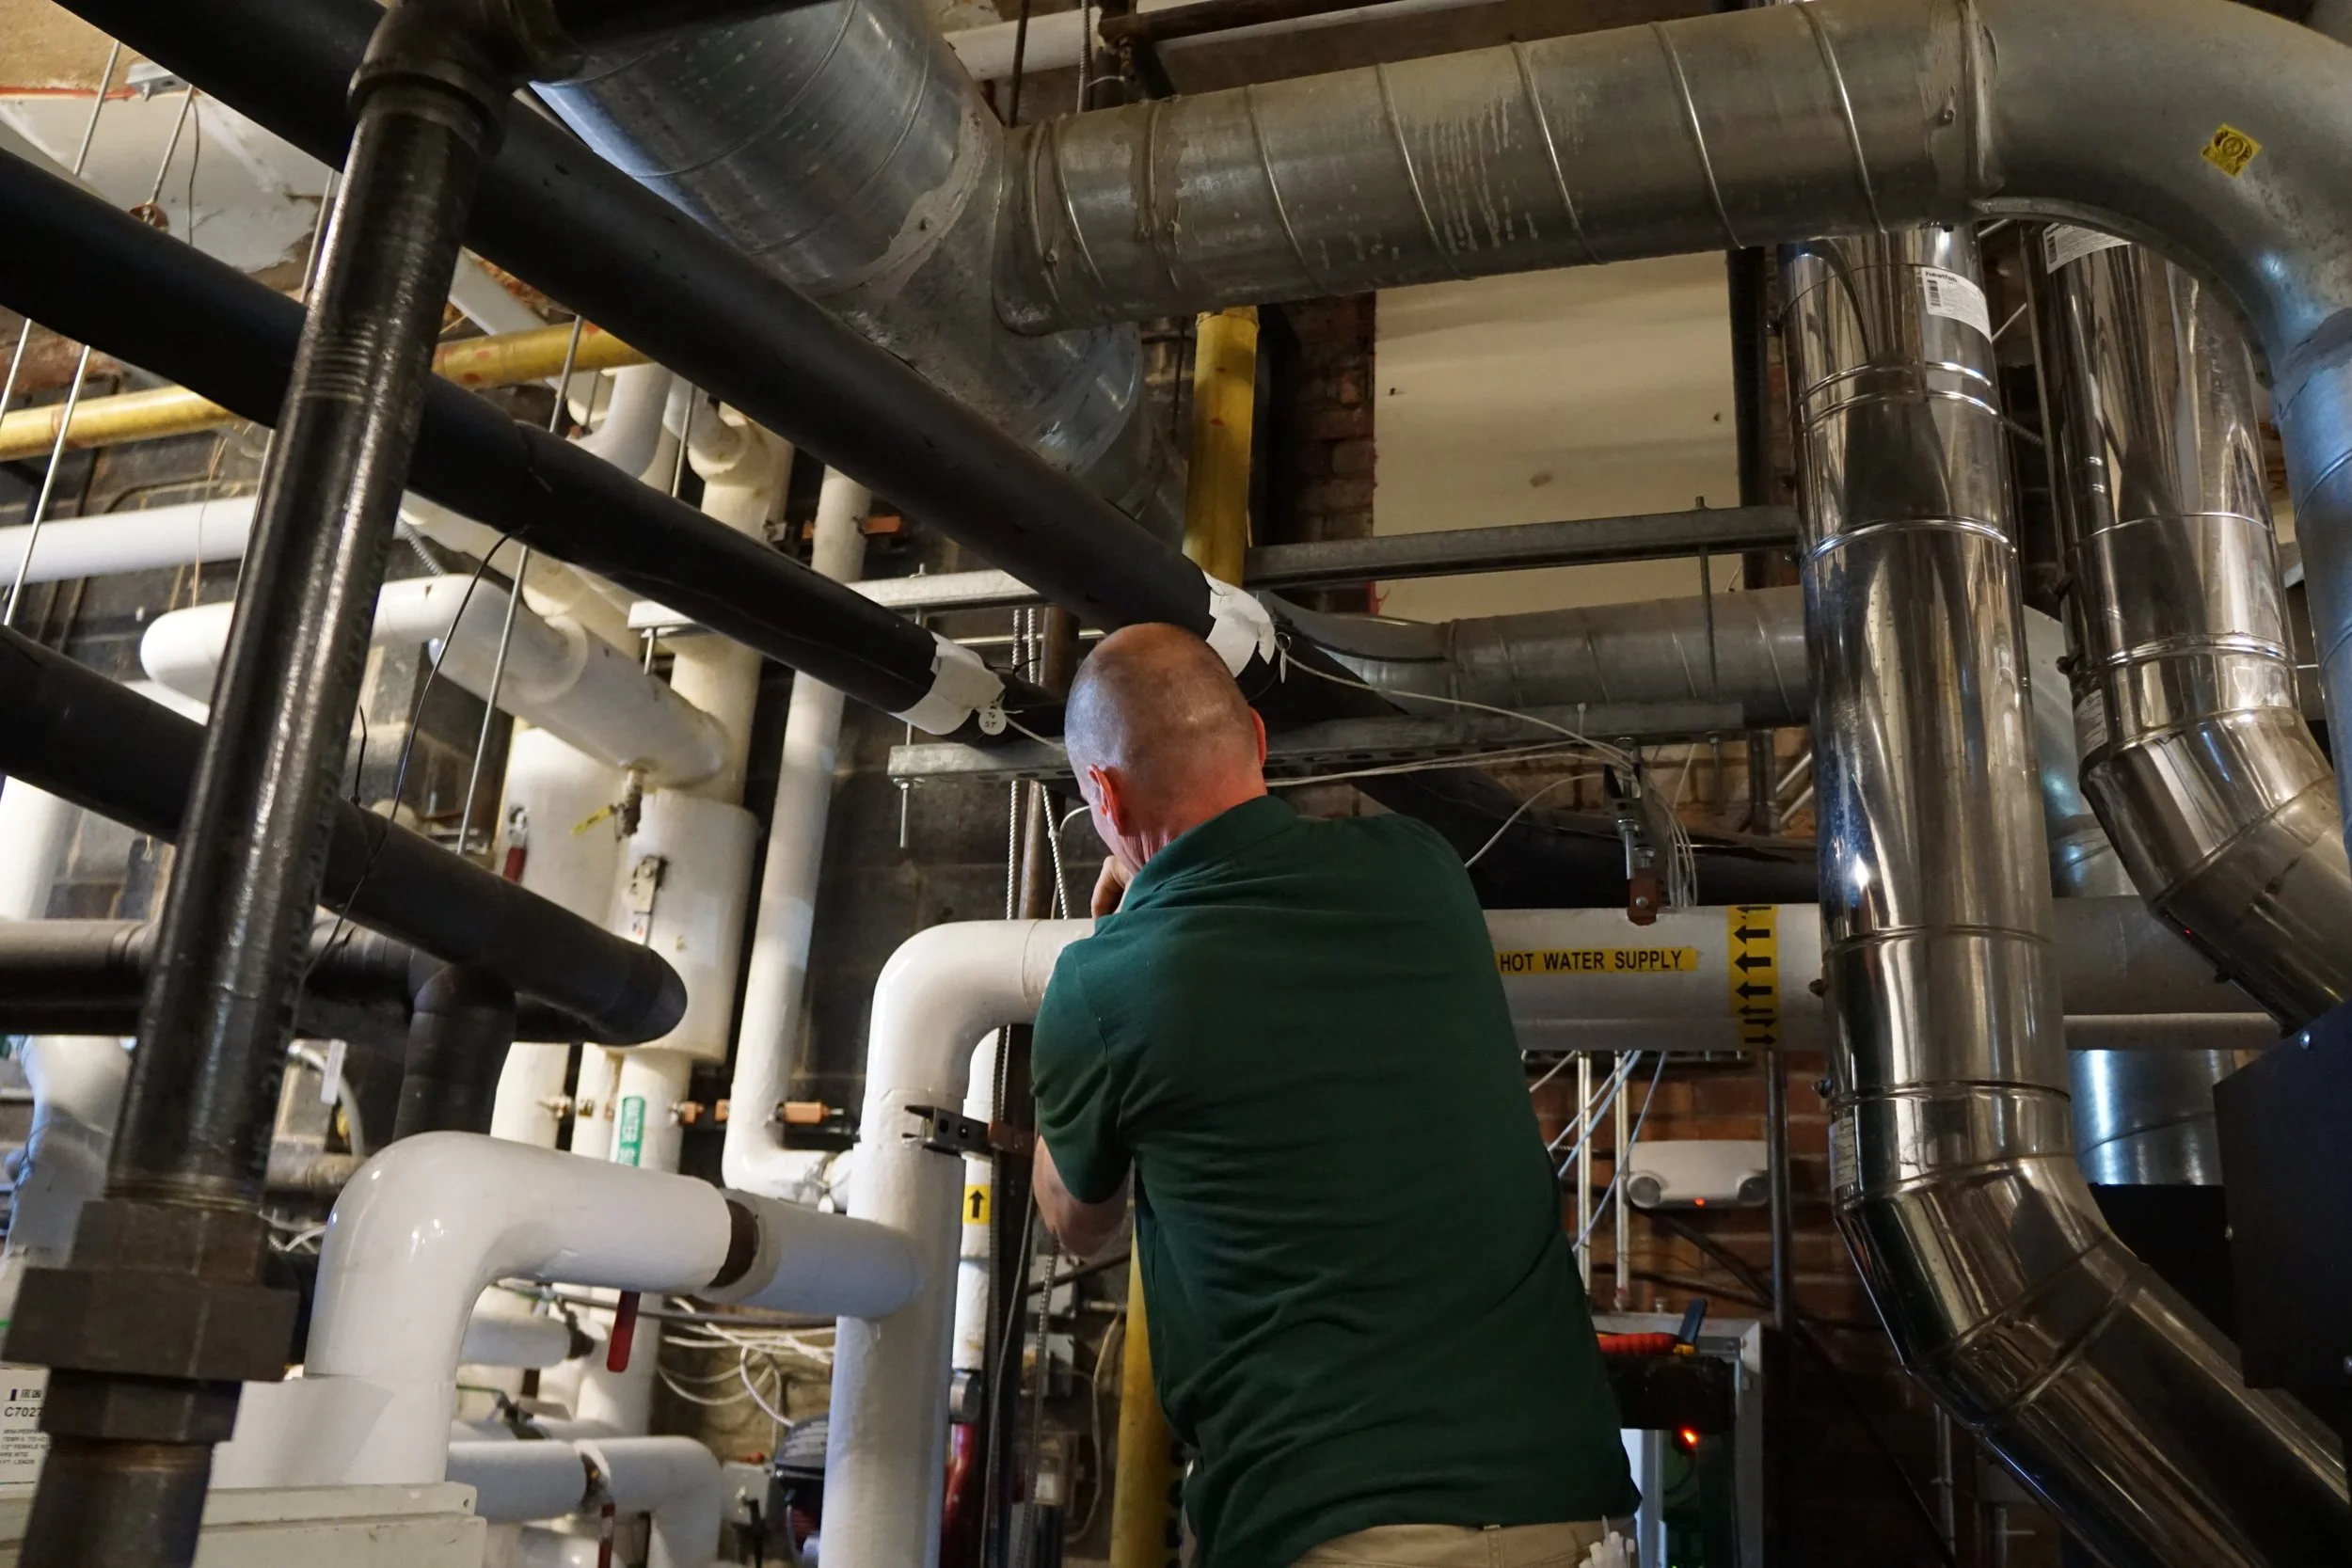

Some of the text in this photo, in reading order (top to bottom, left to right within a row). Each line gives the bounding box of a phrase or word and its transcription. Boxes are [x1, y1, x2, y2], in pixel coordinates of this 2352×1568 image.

[1500, 950, 1682, 972] HOT WATER SUPPLY
